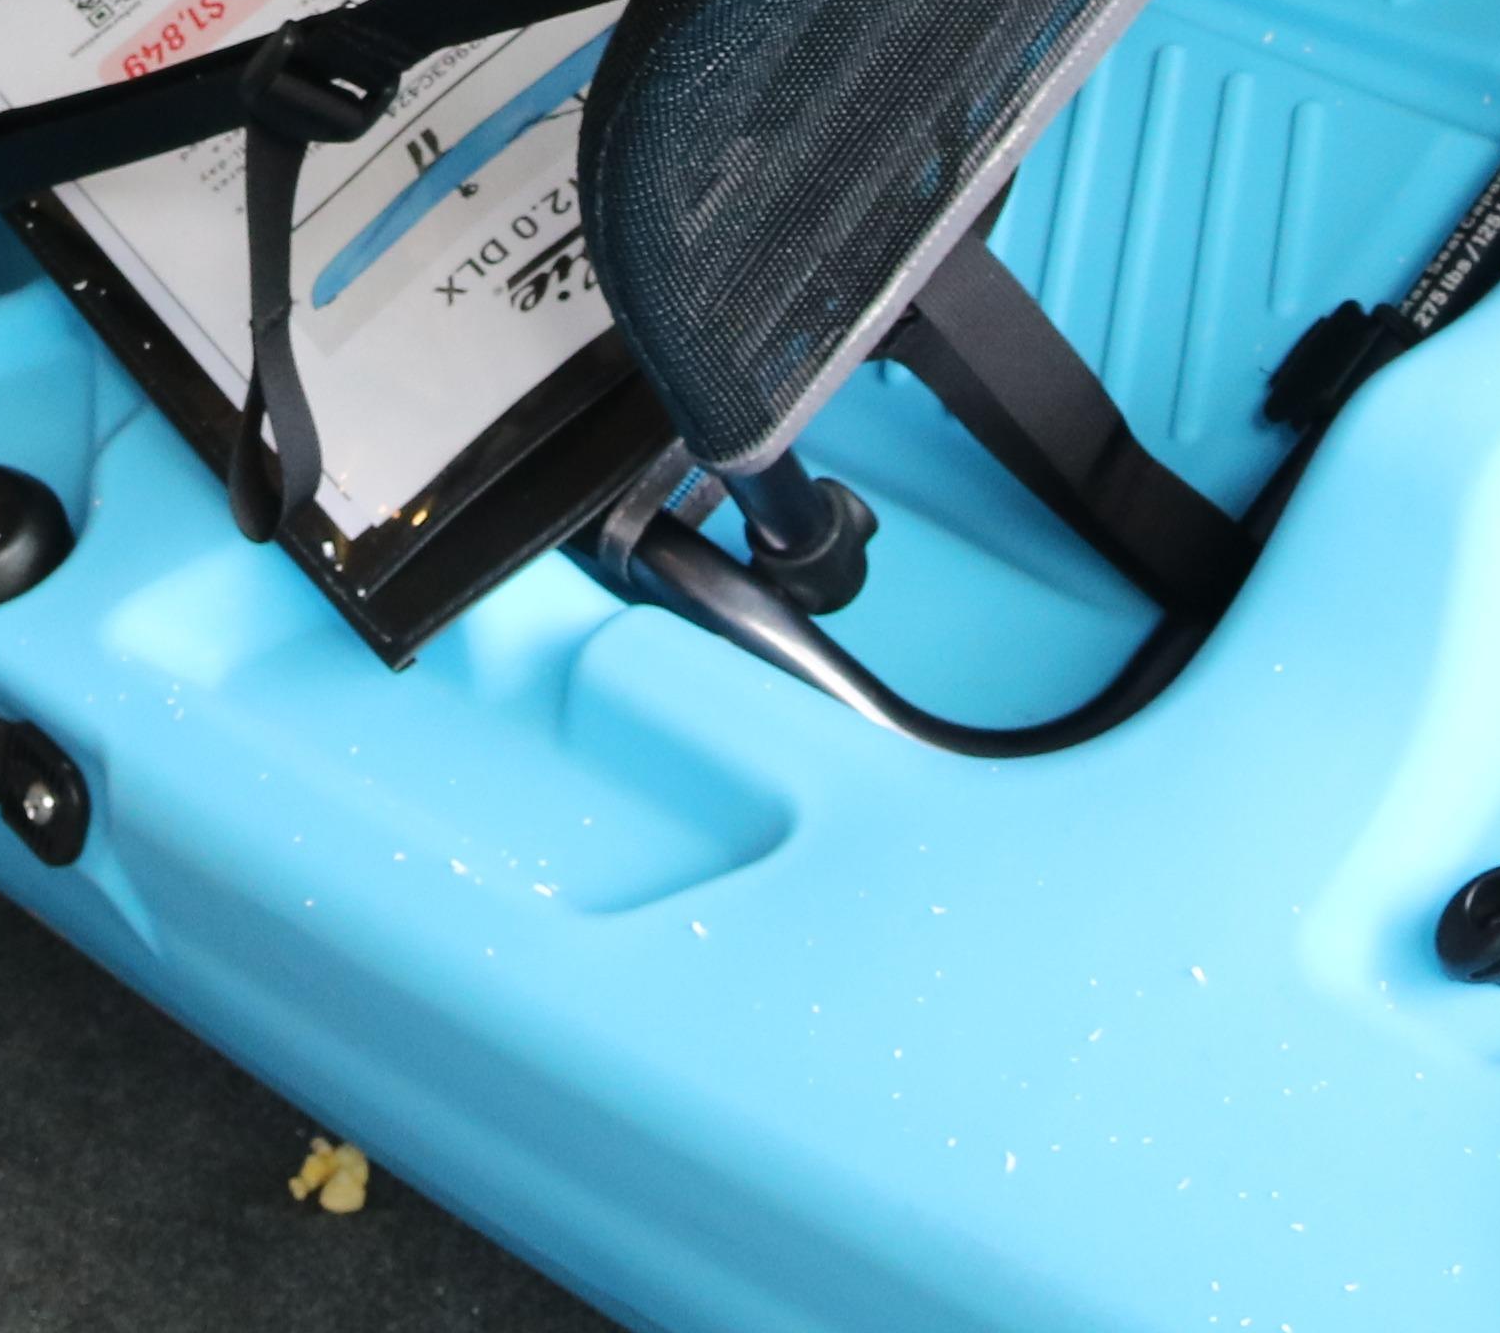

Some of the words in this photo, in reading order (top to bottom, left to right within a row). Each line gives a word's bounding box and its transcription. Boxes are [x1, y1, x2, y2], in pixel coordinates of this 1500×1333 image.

[510, 176, 578, 240] 2.0
[434, 236, 510, 306] DLX
[1413, 291, 1448, 330] 275
